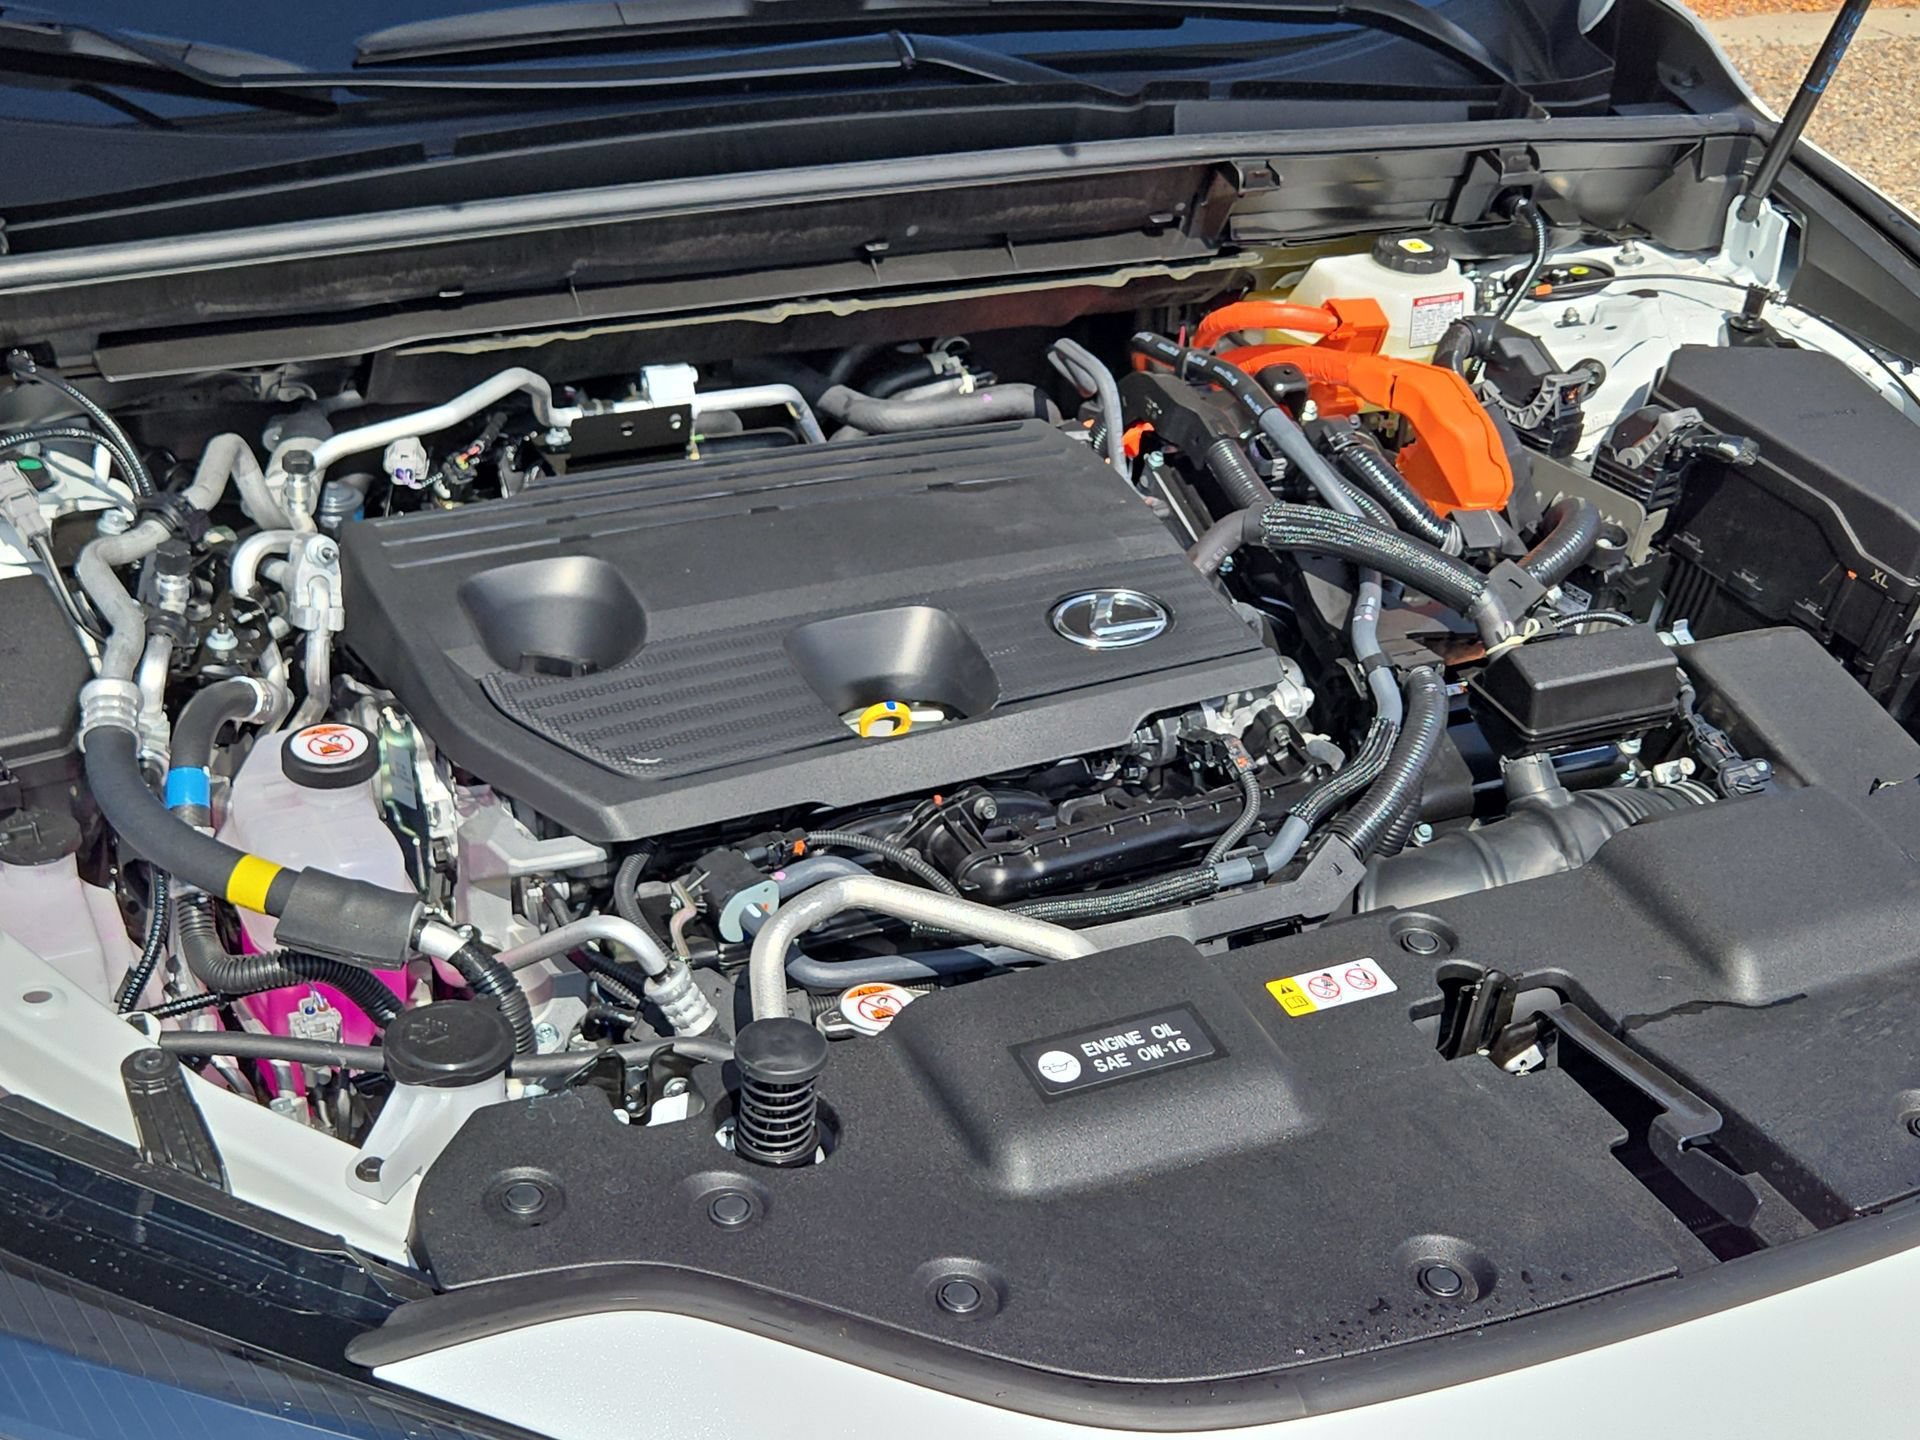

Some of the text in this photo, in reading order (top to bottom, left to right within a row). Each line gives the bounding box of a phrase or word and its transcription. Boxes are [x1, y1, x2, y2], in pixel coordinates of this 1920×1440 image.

[1870, 568, 1889, 590] XL
[1080, 1022, 1182, 1057] ENGINE OIL
[1093, 1038, 1191, 1073] SAE 0W-16
